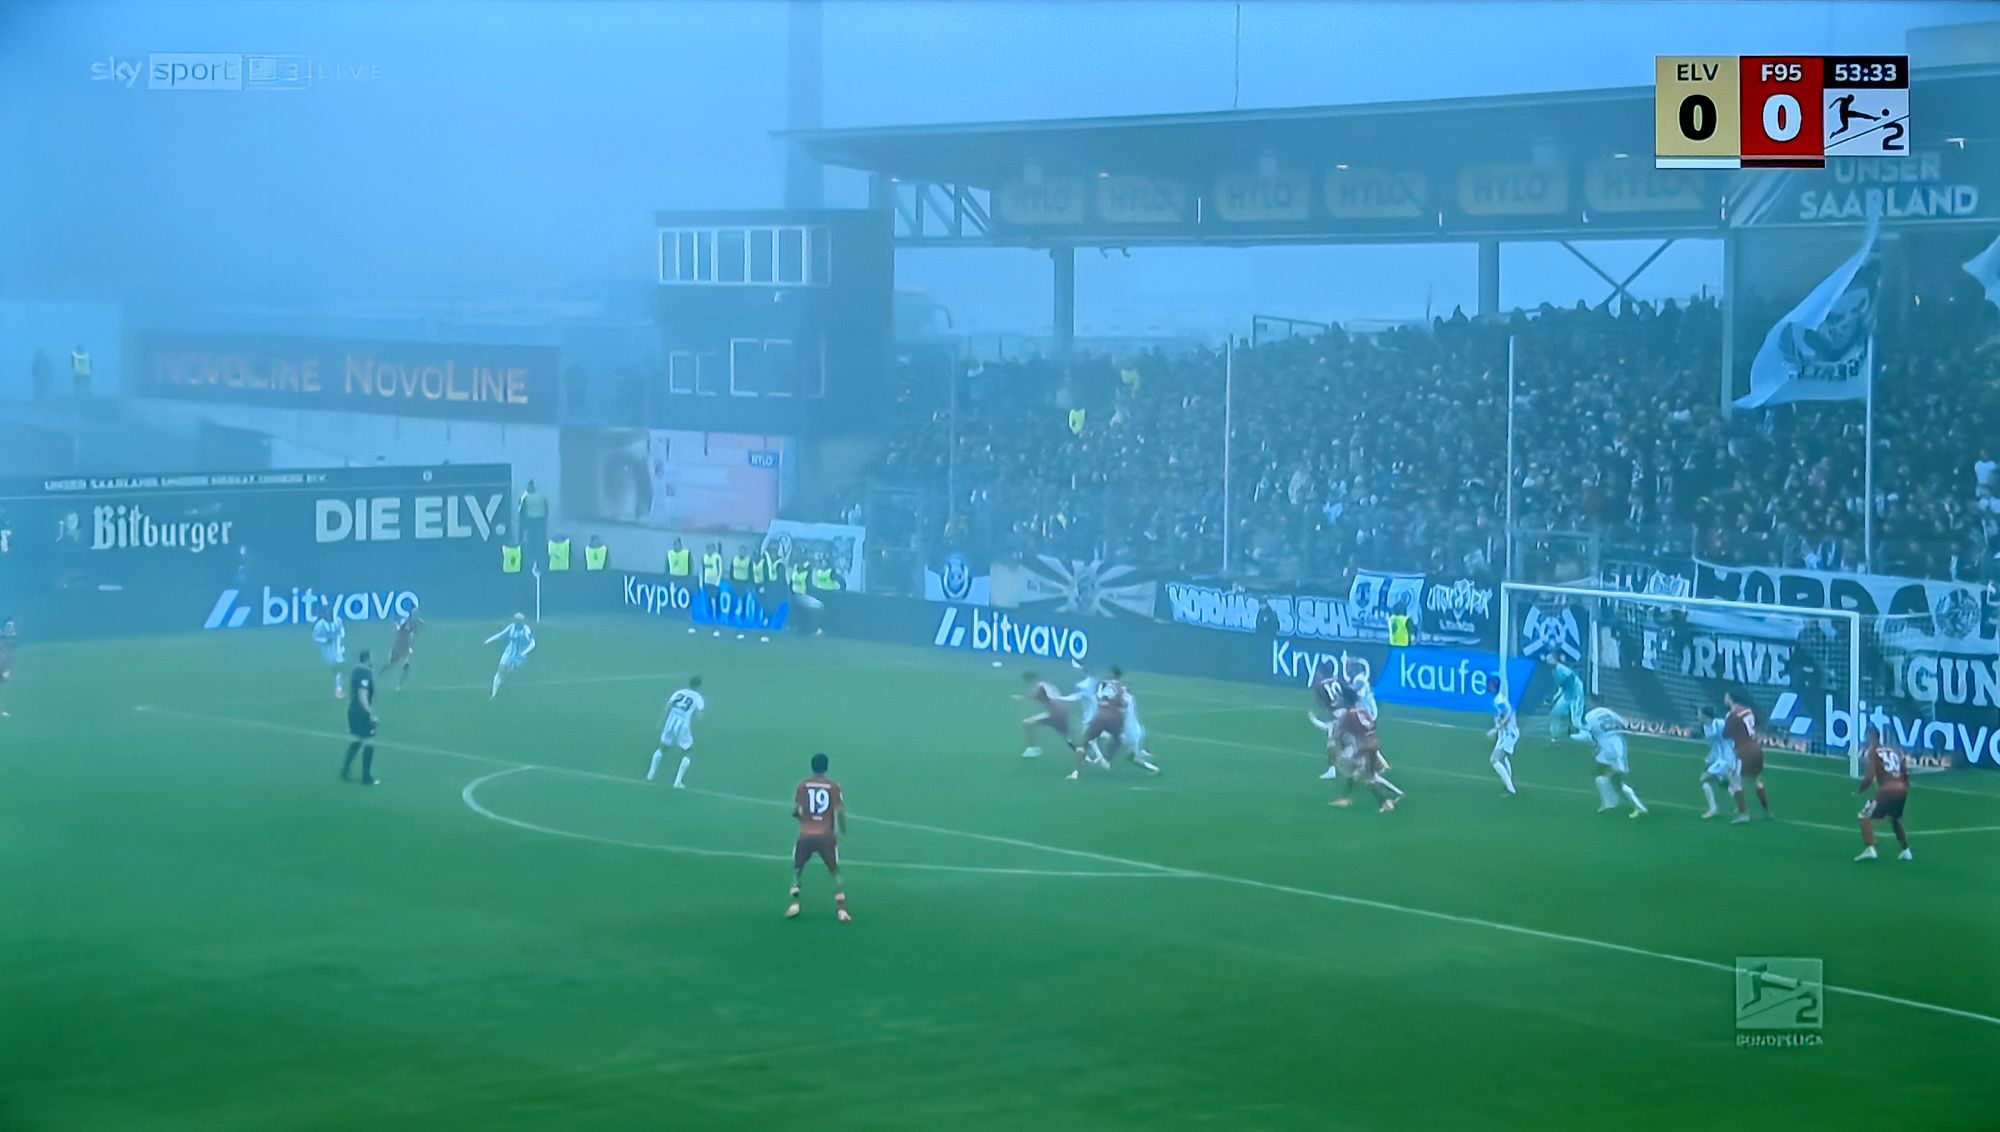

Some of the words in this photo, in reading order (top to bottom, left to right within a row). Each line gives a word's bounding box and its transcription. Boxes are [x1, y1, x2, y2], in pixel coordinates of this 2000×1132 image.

[1834, 152, 1942, 182] UNSER
[1799, 185, 1978, 220] SAARLAND
[91, 504, 232, 552] Bitburger
[316, 498, 400, 542] DIE
[415, 494, 506, 541] ELV.
[623, 574, 690, 615] Krypto
[973, 608, 1088, 659] bitvavo
[1401, 653, 1501, 696] kaufe
[808, 789, 829, 814] 19
